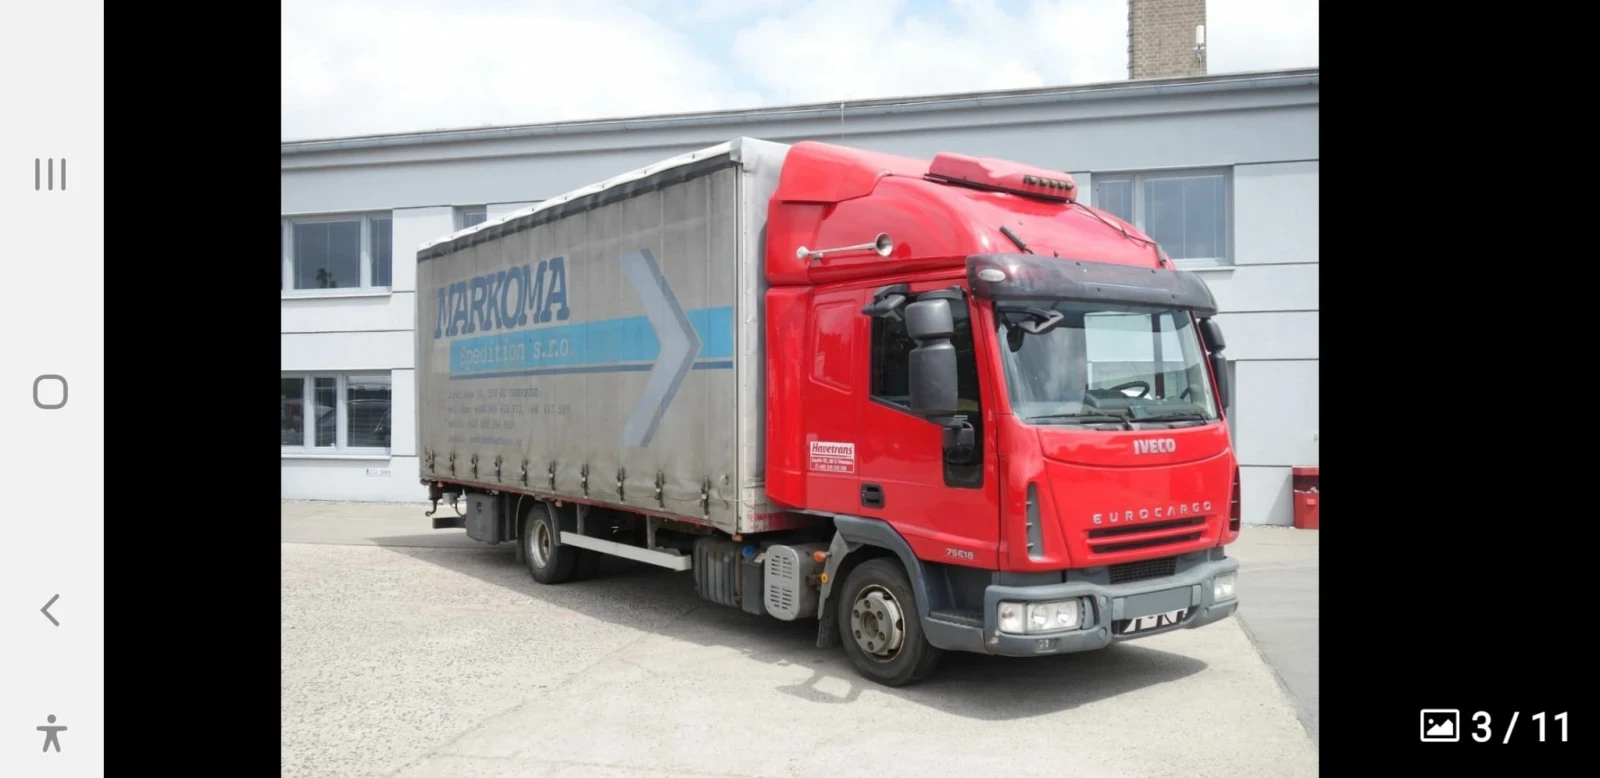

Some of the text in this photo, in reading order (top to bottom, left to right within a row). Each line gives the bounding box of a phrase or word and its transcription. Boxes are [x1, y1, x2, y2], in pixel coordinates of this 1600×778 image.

[434, 256, 570, 339] MARKOMA
[460, 338, 525, 370] Spedition
[812, 442, 853, 455] Havetrans
[1133, 438, 1176, 455] IVECO
[1093, 501, 1212, 524] EUROCARGO
